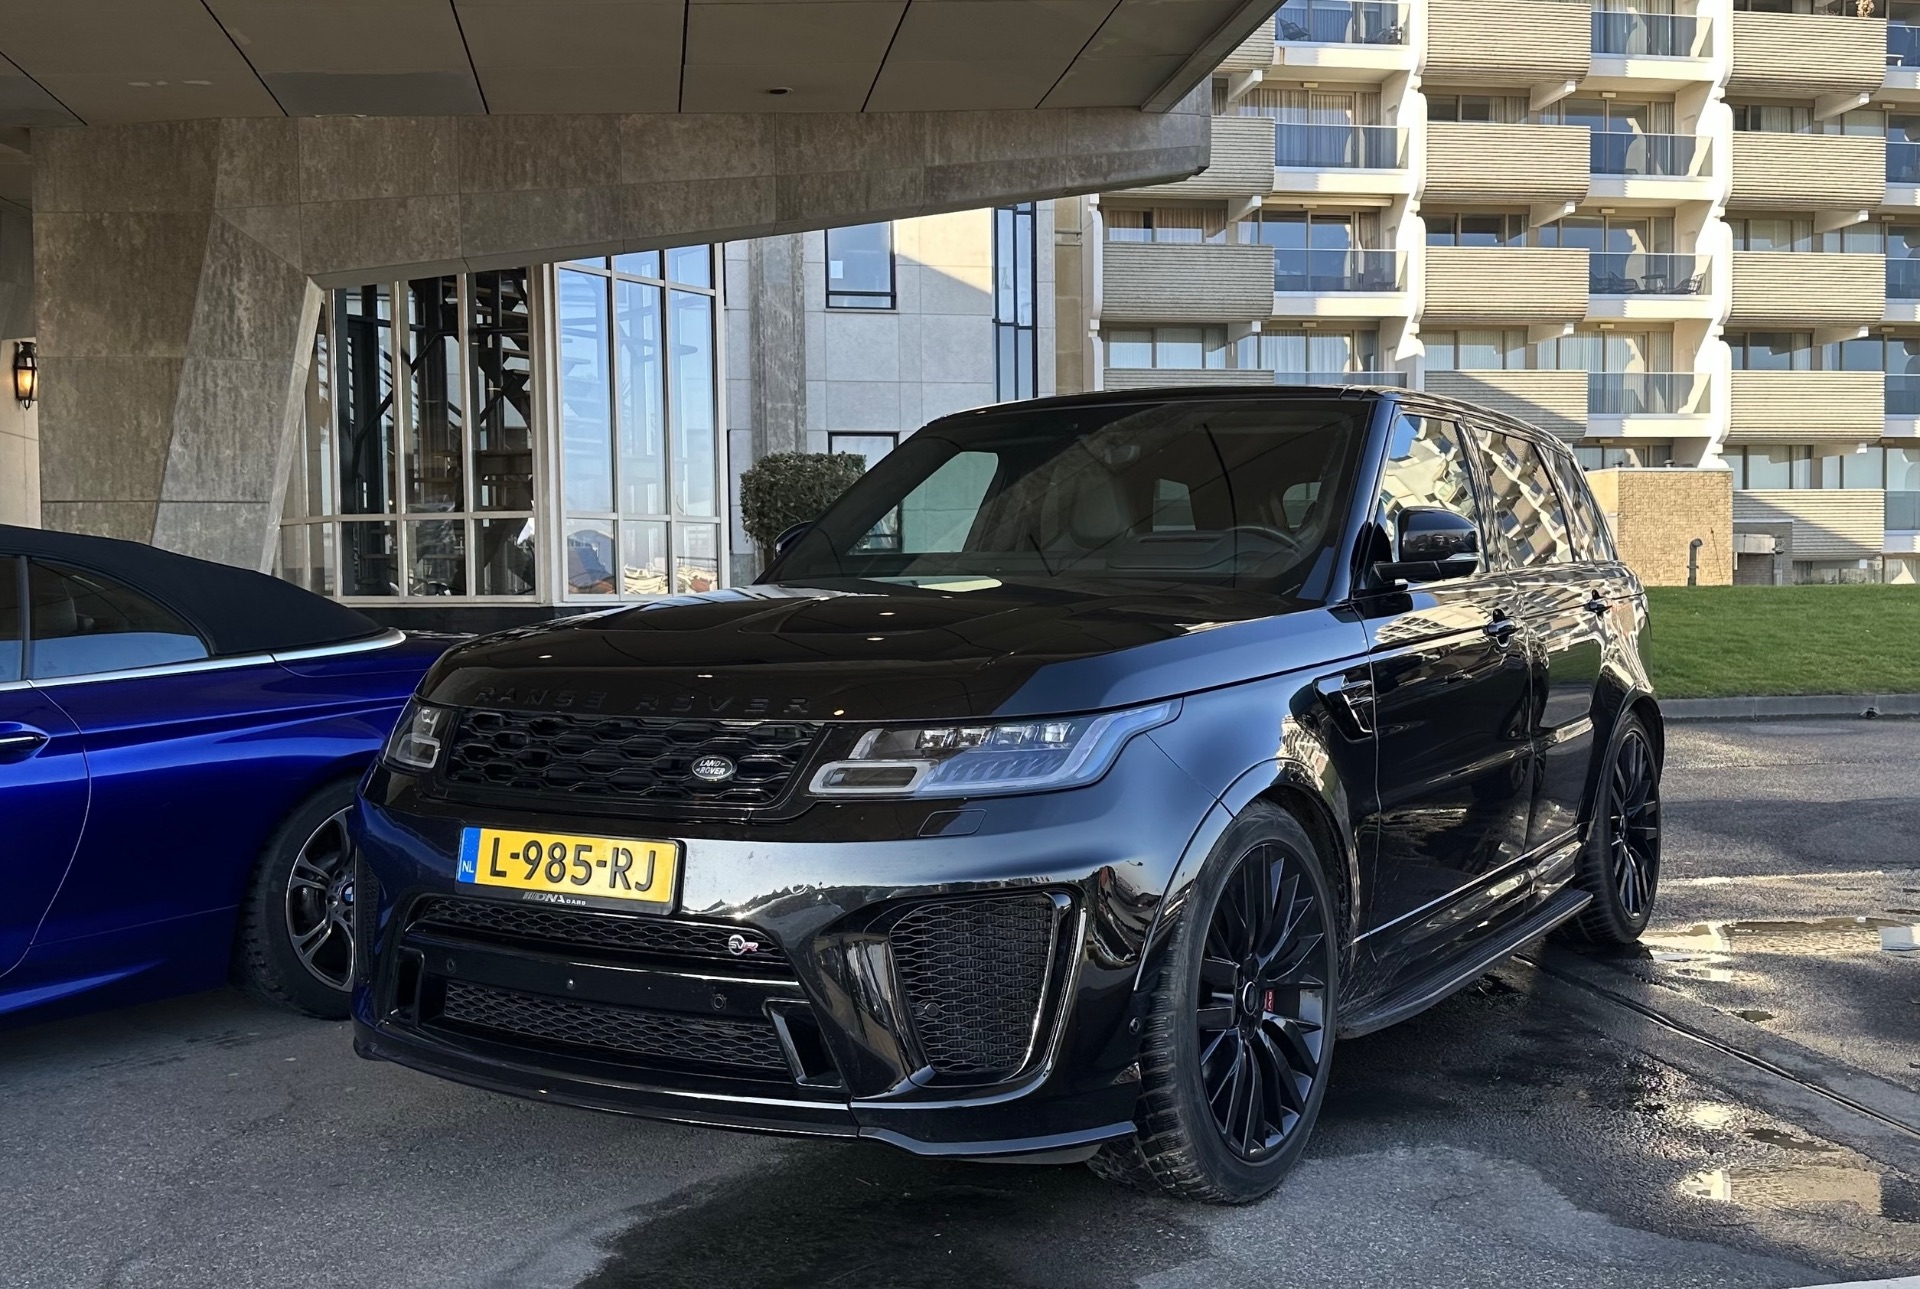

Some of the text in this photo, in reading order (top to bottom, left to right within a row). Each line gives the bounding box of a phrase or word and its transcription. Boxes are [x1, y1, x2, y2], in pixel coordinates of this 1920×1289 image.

[474, 687, 809, 713] RANGE ROVER
[699, 759, 721, 767] LAND
[699, 766, 725, 775] ROVER
[462, 860, 475, 873] NL
[489, 837, 656, 892] L-985-RJ
